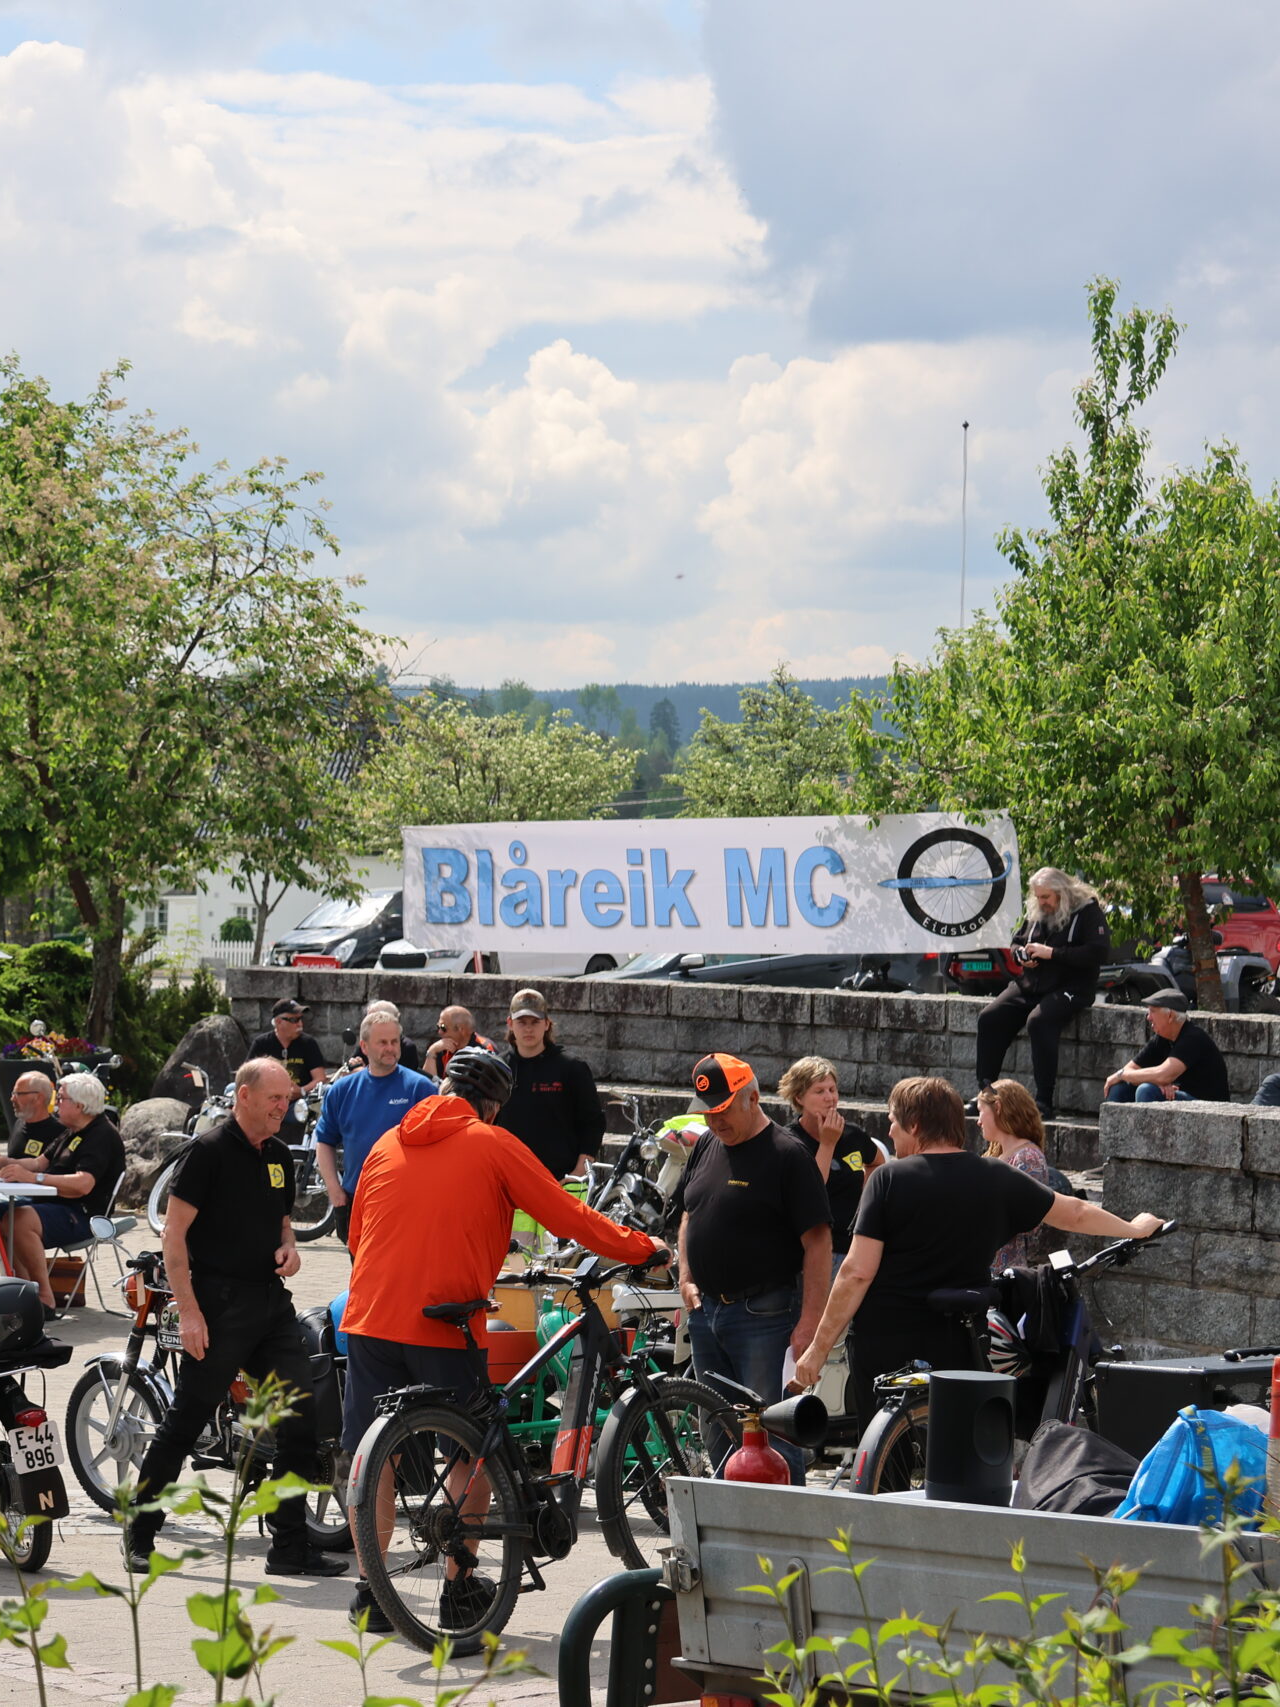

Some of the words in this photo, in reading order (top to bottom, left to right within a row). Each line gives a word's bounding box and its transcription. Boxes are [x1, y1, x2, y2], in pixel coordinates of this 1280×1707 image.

[422, 840, 699, 927] Blåreik
[724, 846, 848, 927] MC
[922, 916, 986, 936] Eidskog
[161, 1334, 181, 1345] ZÜN
[15, 1424, 54, 1450] E-44
[25, 1446, 55, 1469] 896
[38, 1490, 55, 1511] N
